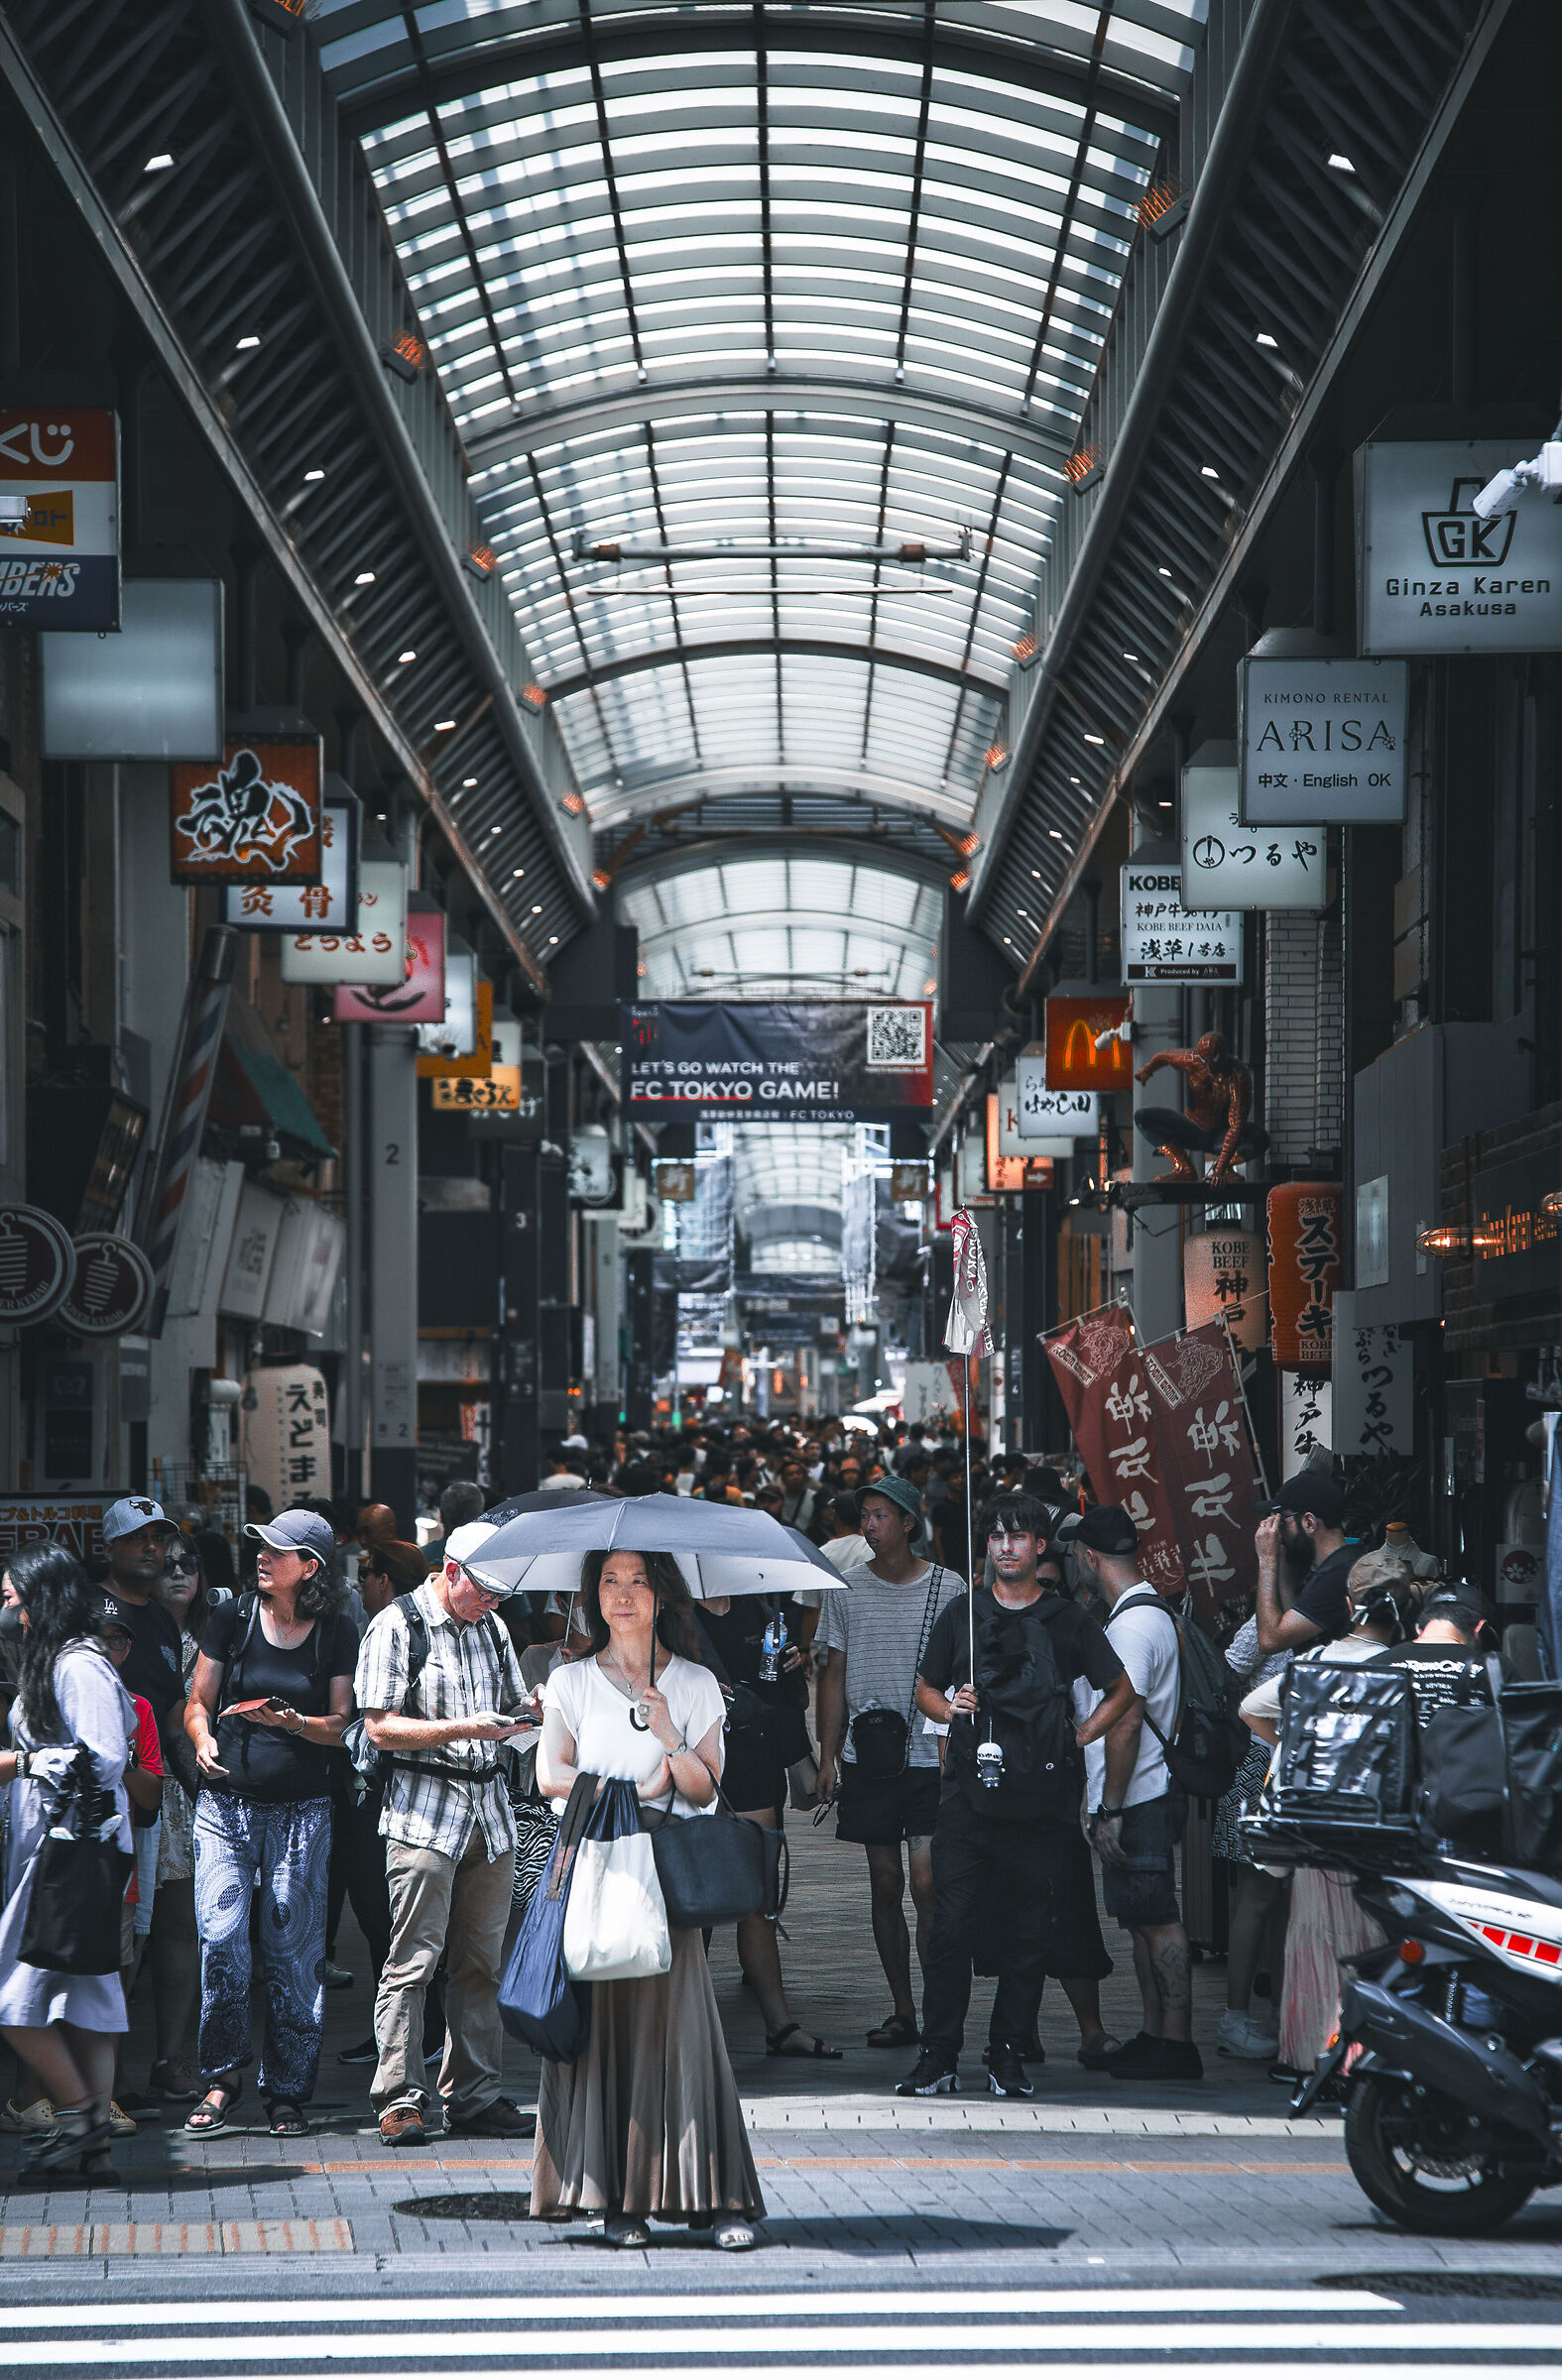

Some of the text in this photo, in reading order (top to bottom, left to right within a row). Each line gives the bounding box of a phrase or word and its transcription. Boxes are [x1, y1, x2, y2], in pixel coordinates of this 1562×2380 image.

[1438, 521, 1502, 558] GK
[1386, 576, 1551, 596] Ginza Karen
[1419, 601, 1516, 616] Asakusa
[1263, 693, 1389, 704] KIMONO RENTAL
[1256, 720, 1396, 752] ARISA
[1303, 774, 1358, 788] English
[1137, 921, 1165, 931] KOBE
[1168, 921, 1194, 931] BEEF
[632, 1061, 799, 1075] LET'S GO WATCH THE
[631, 1081, 839, 1100] FC TOKYO GAME!
[810, 1110, 855, 1120] TOKYO
[386, 1144, 400, 1165] 2
[1211, 1241, 1250, 1254] KOBE
[1212, 1255, 1249, 1269] BEEF
[104, 1599, 118, 1614] LA
